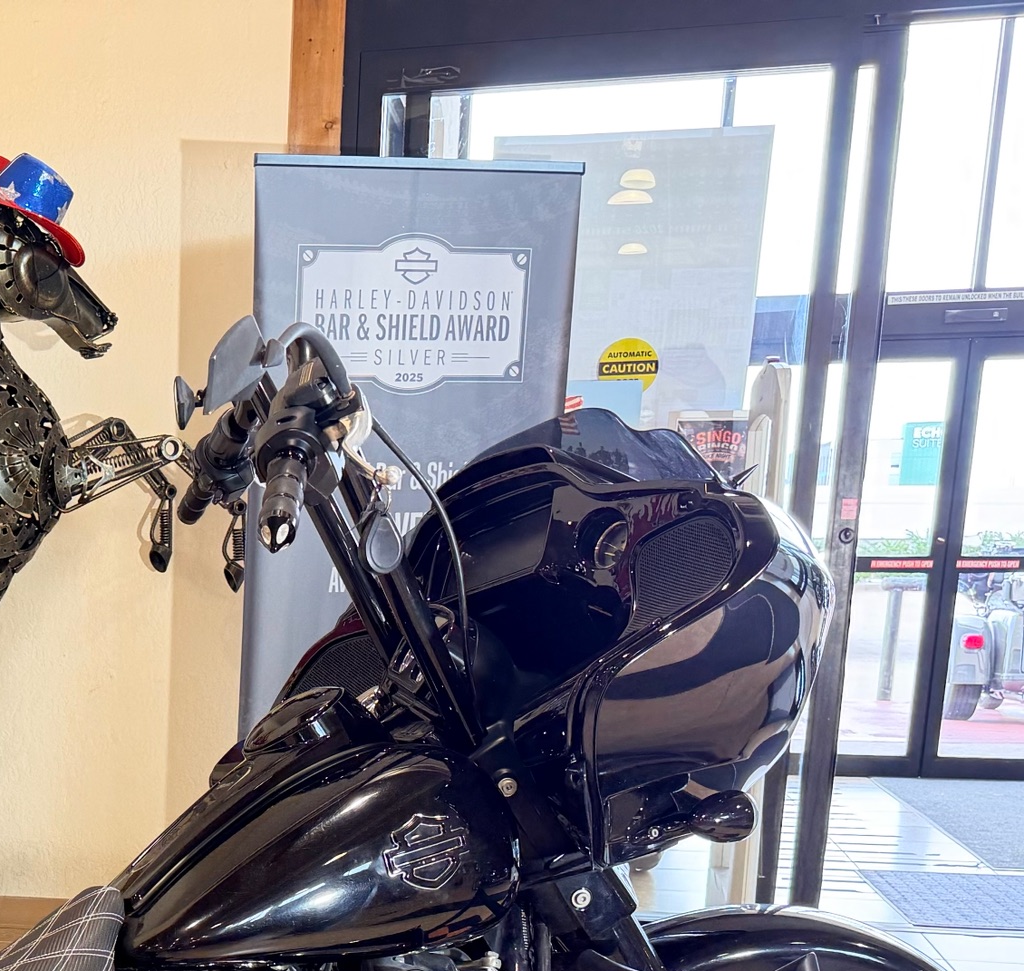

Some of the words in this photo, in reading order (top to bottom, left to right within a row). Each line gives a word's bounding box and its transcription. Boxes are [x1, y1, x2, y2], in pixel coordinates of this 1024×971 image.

[315, 288, 511, 311] HARLEY-DAVIDSON
[315, 314, 350, 341] BAR
[356, 313, 370, 341] &
[376, 314, 440, 341] SHIELD
[445, 314, 510, 342] AWARD
[373, 349, 446, 366] SILVER
[608, 351, 653, 359] AUTOMATIC
[602, 362, 656, 374] CAUTION
[394, 372, 424, 383] 2025
[696, 429, 742, 446] SINGO
[913, 426, 942, 439] ECH
